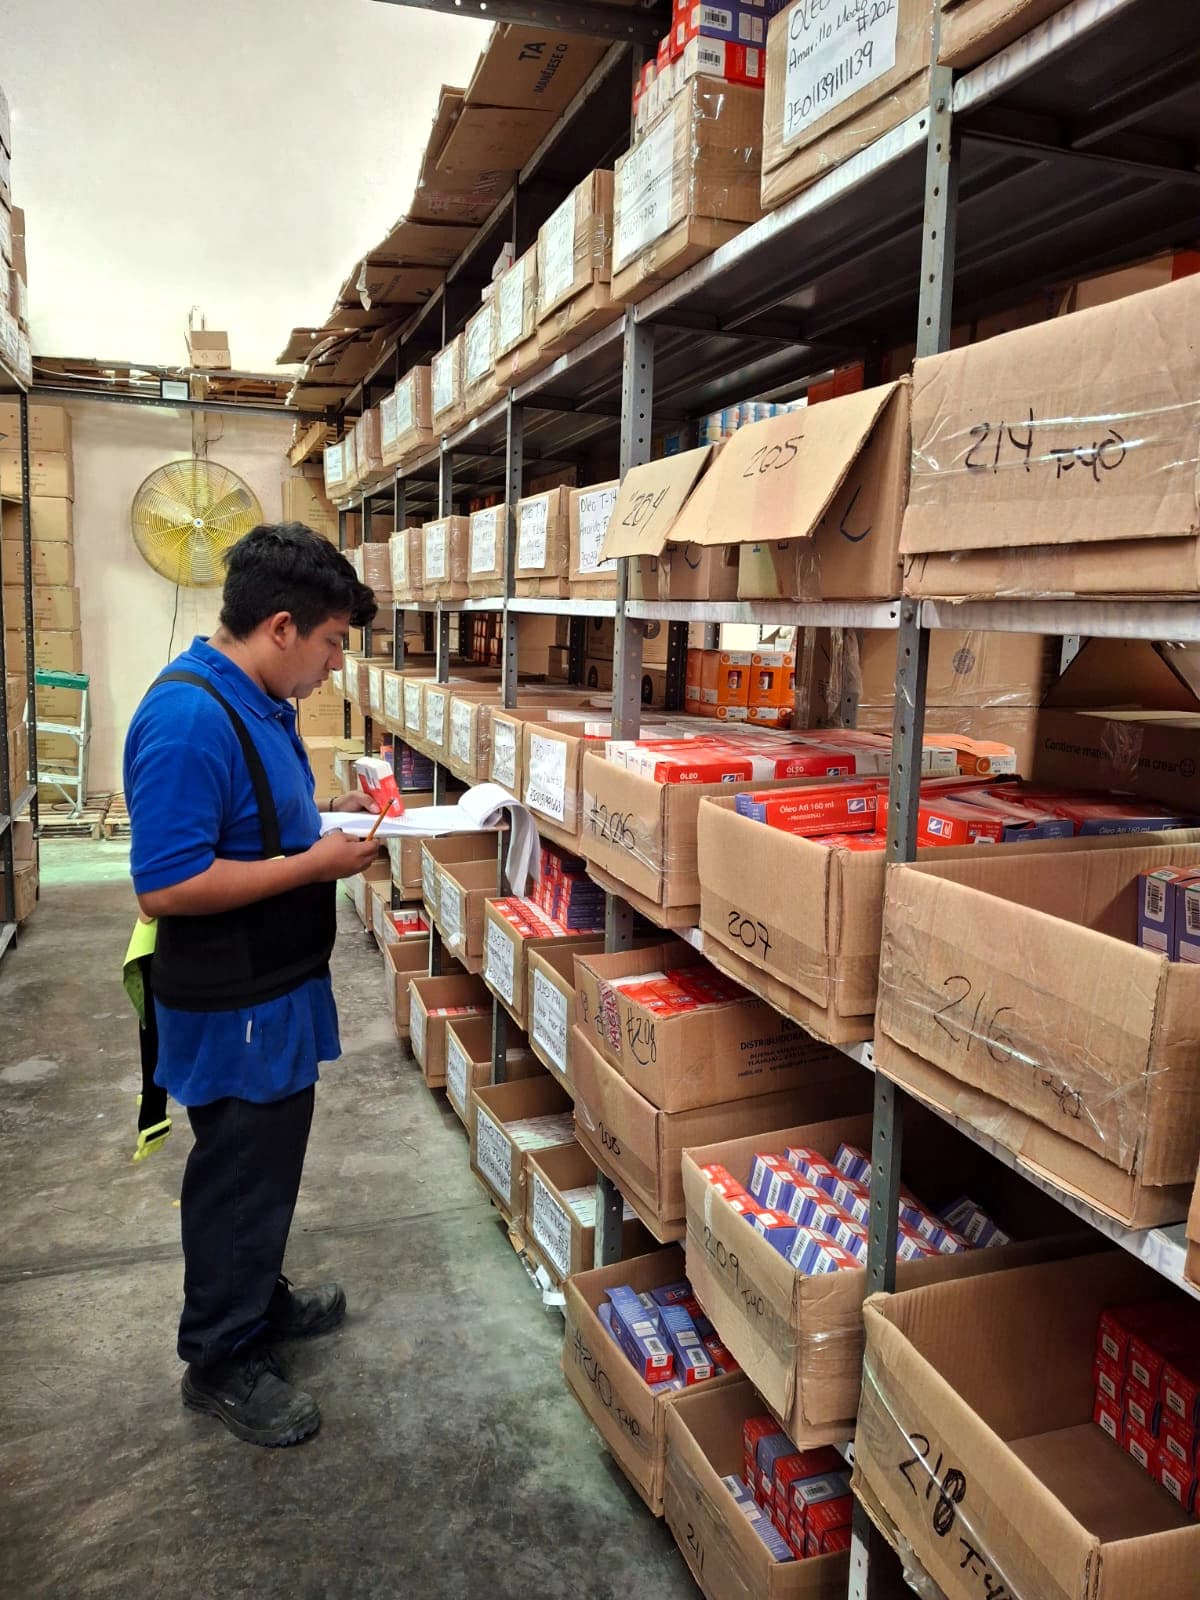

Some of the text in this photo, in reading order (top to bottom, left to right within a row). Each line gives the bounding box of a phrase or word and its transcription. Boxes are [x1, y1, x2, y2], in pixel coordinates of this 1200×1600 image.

[742, 434, 805, 478] 205
[964, 407, 1033, 474] 214
[622, 486, 670, 536] 204
[779, 803, 797, 814] Óleo
[728, 911, 772, 961] 207
[934, 975, 1015, 1064] 216
[704, 1225, 739, 1288] 209
